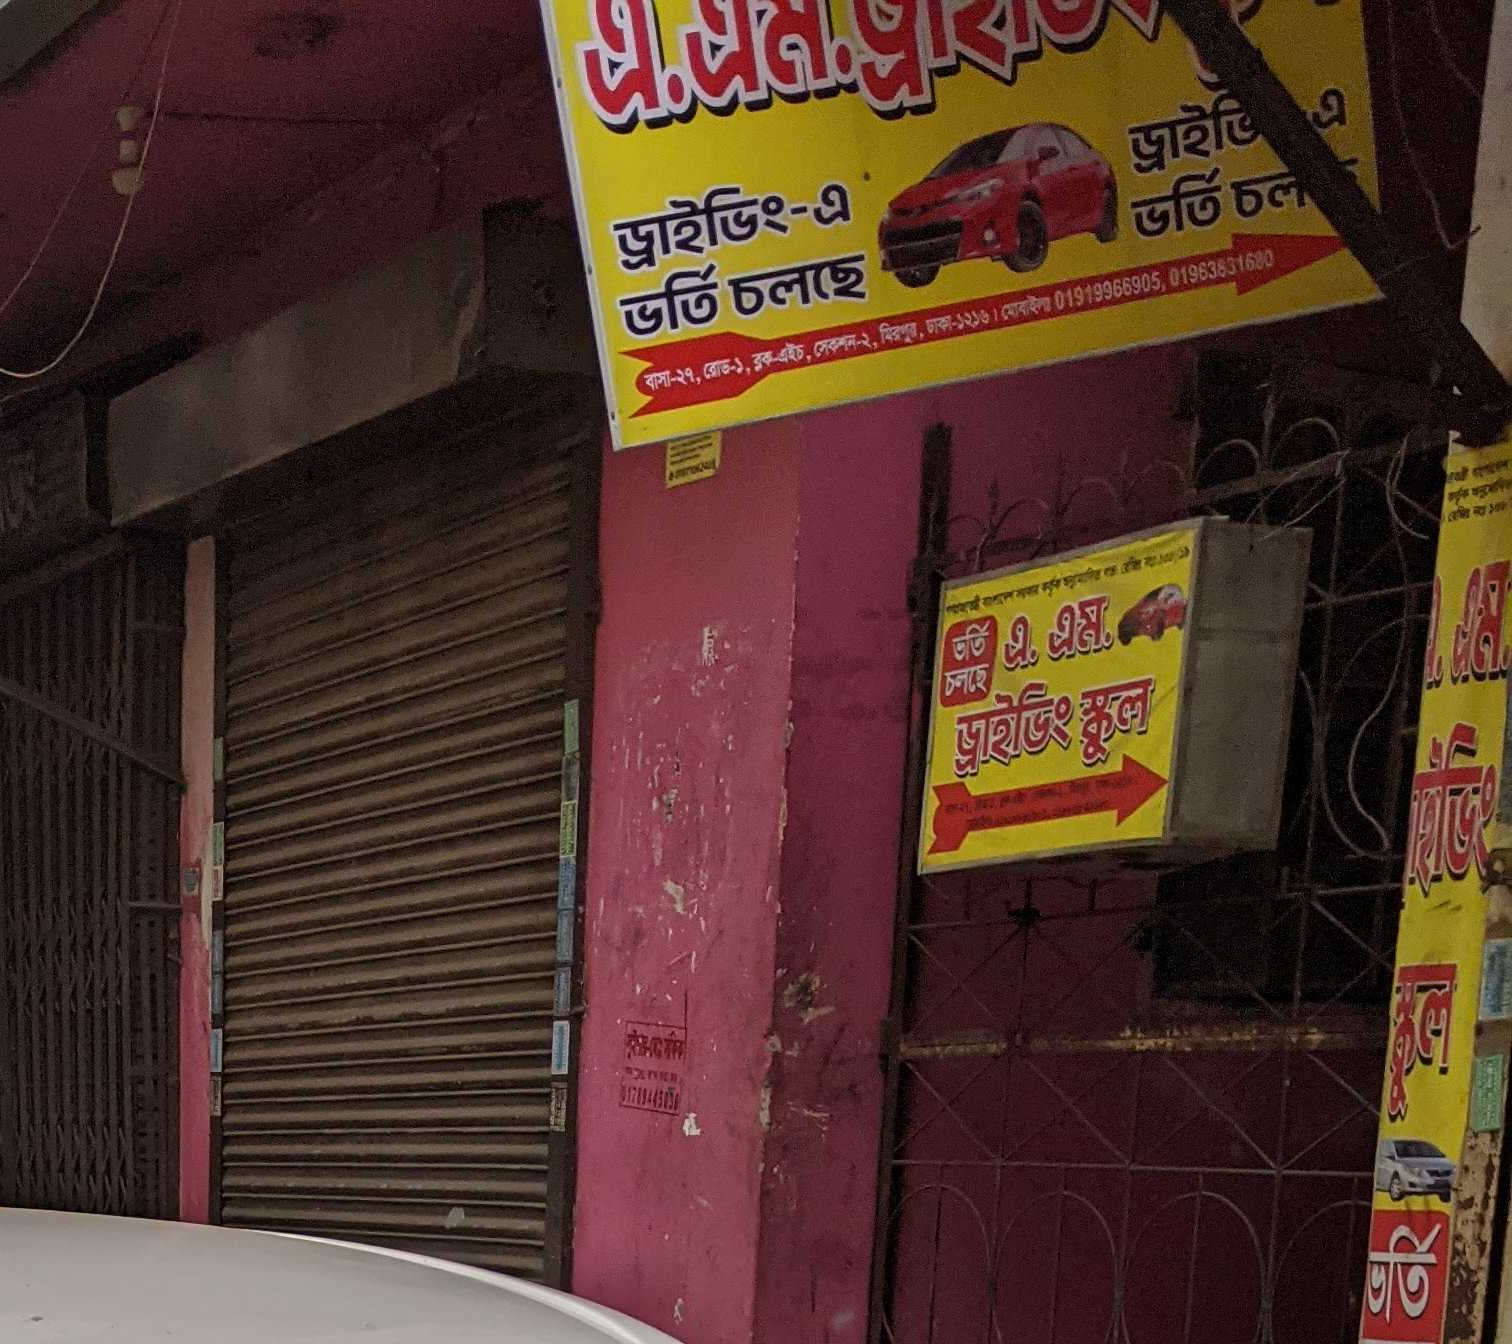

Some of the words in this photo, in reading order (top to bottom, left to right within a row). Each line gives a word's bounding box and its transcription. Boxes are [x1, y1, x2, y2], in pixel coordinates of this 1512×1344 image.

[612, 184, 851, 271] ড্রাইভিং-এ
[1130, 167, 1222, 237] ভর্তি
[619, 263, 718, 336] ভর্তি
[727, 254, 866, 316] চলছে
[953, 622, 990, 662] ভর্তি
[1048, 595, 1113, 660] এম.
[945, 663, 988, 695] চলছে
[954, 682, 1073, 778] ড্রাইভিং
[1079, 677, 1155, 766] স্কুল
[1367, 1224, 1442, 1325] ভর্তি
